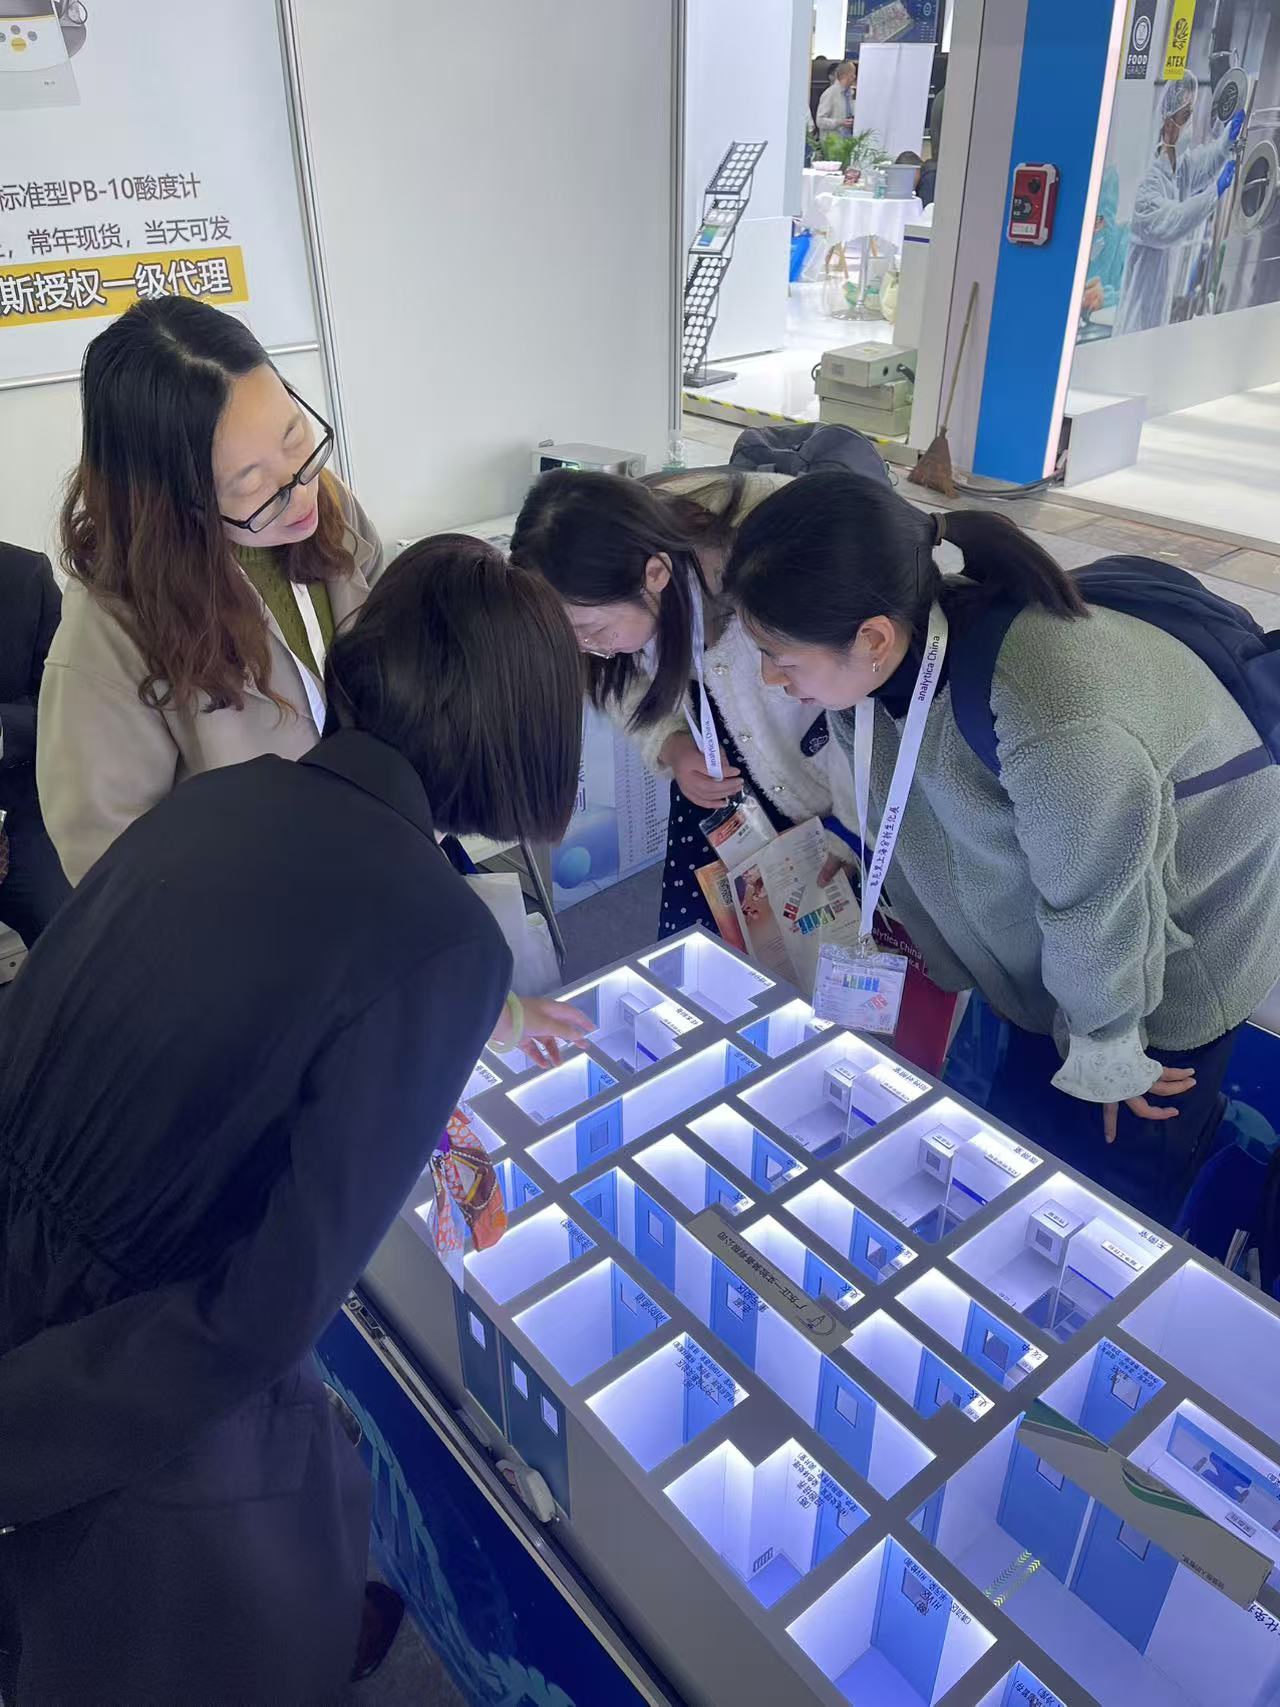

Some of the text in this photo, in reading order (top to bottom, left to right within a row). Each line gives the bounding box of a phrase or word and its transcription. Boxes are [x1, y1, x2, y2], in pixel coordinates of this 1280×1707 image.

[1127, 54, 1148, 65] FOOD
[1166, 55, 1186, 68] ATEX
[917, 634, 942, 702] analytica China
[899, 940, 922, 960] China
